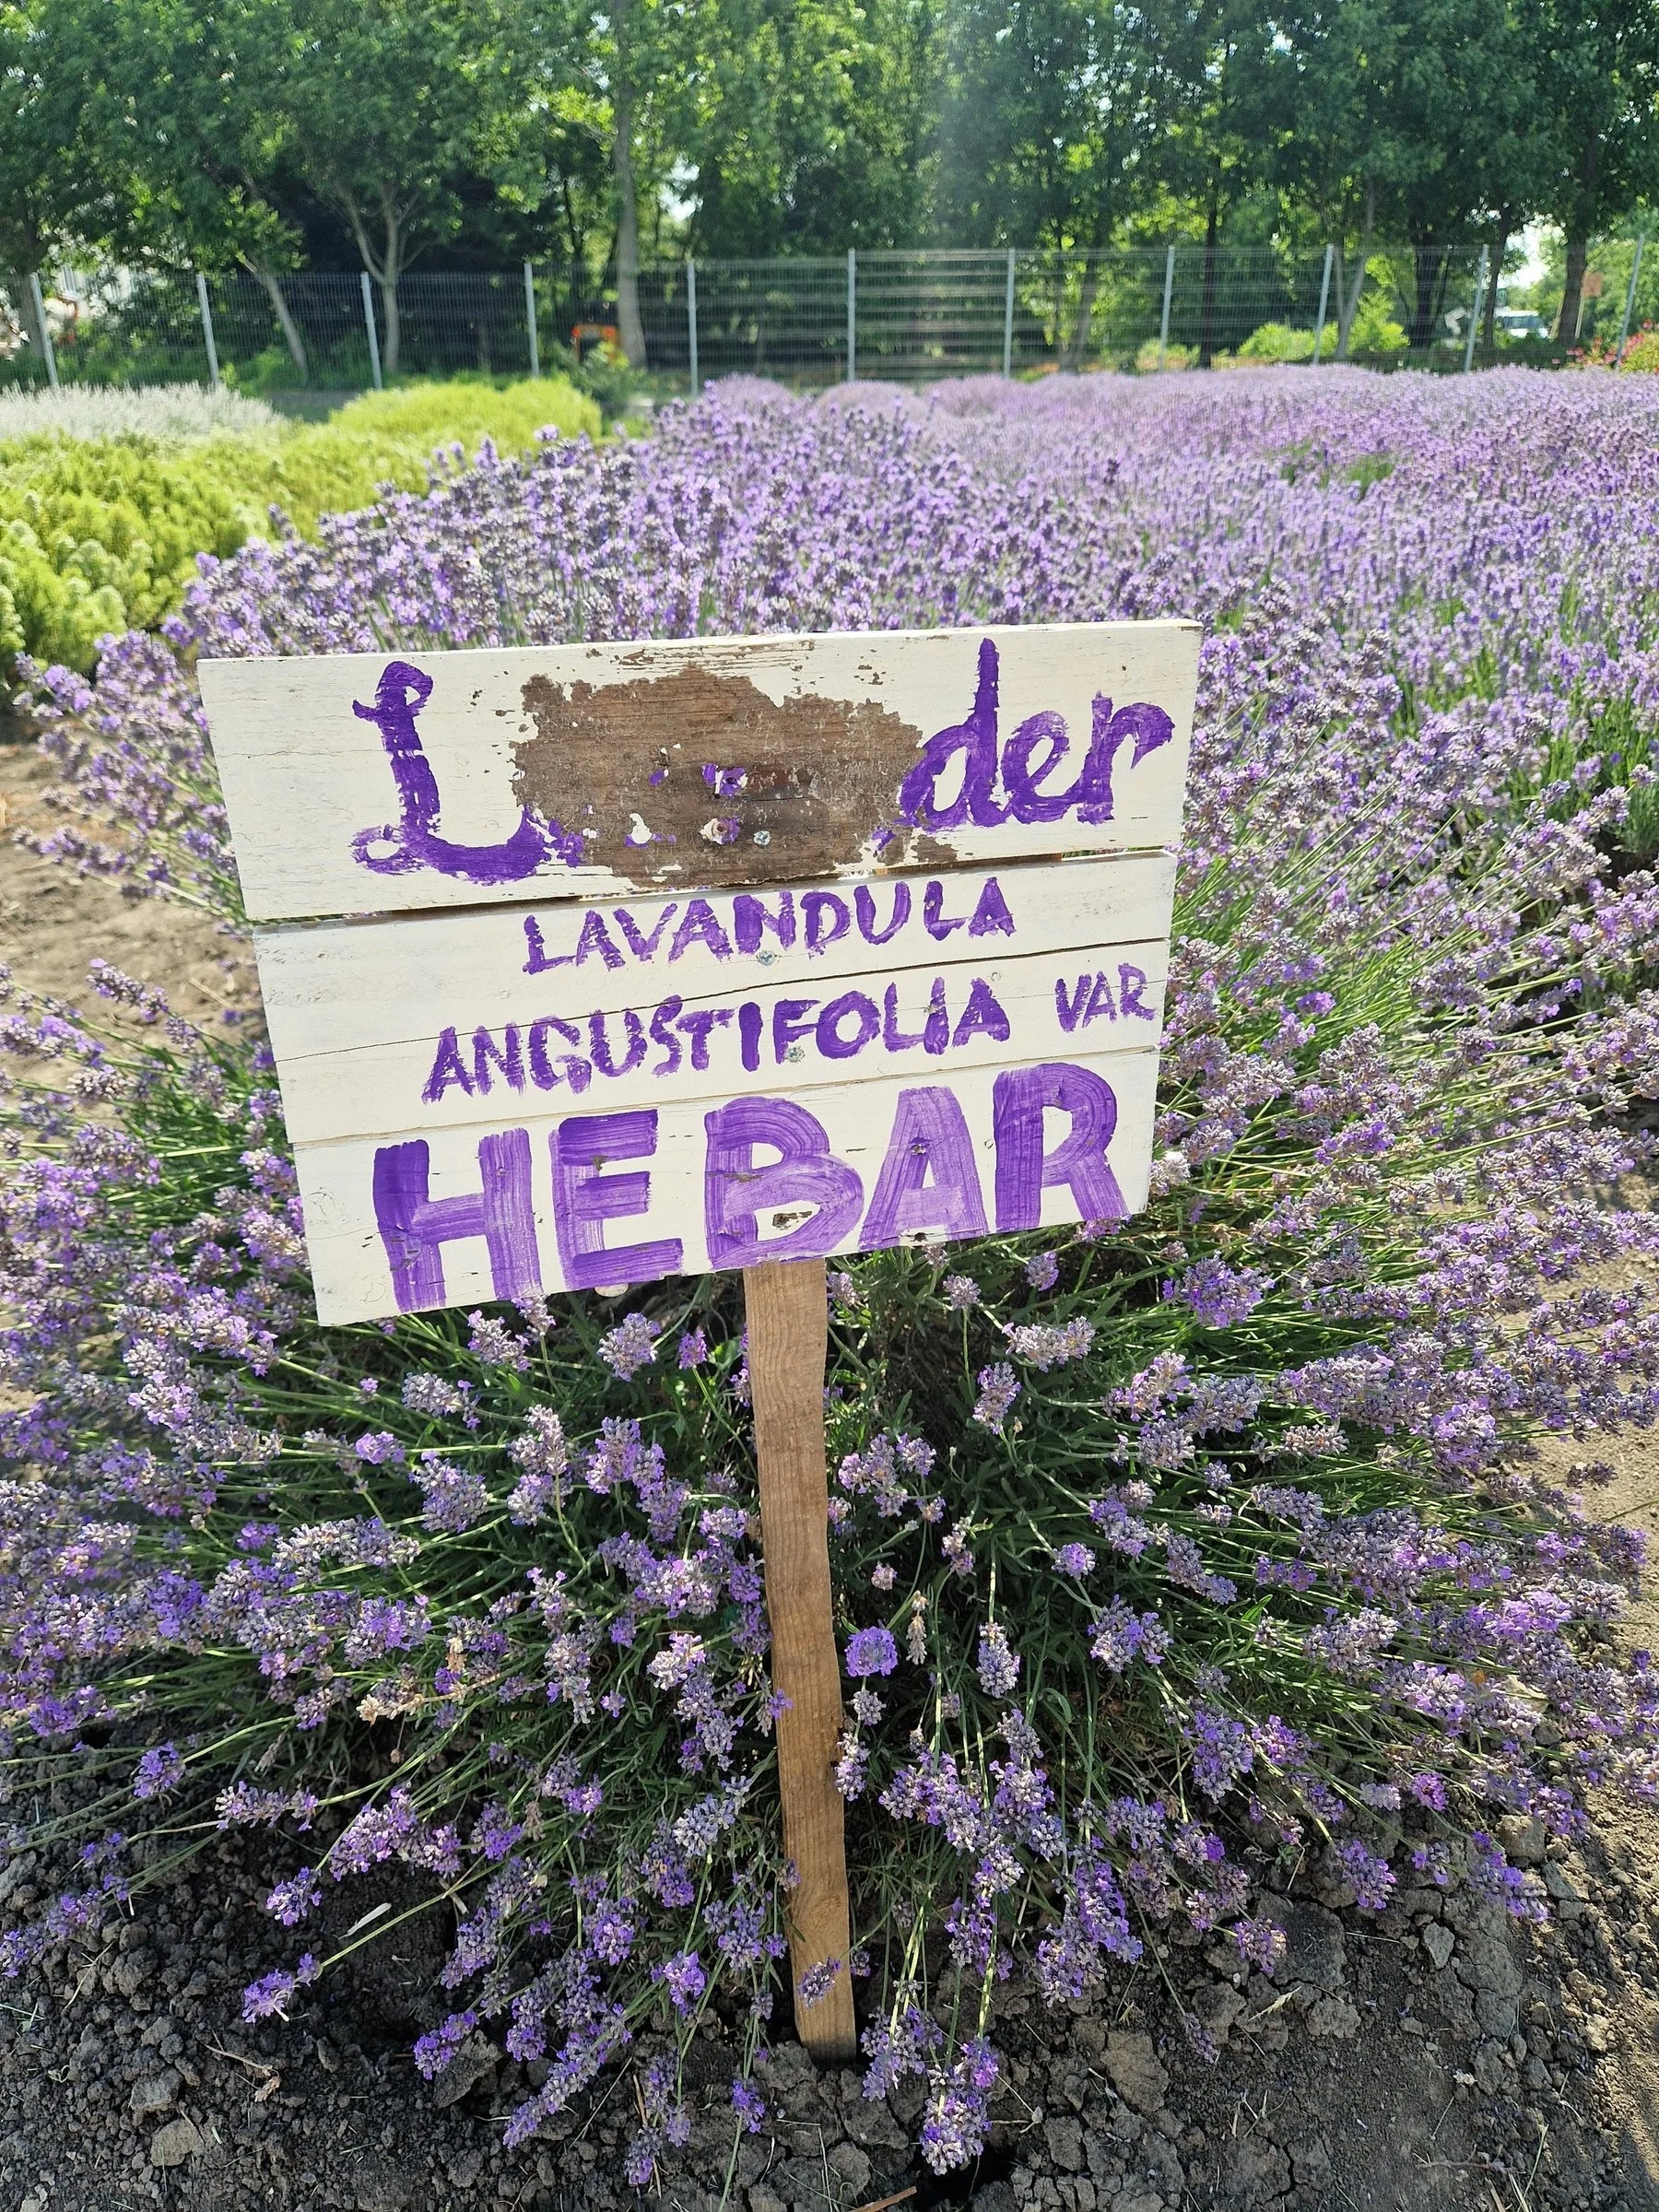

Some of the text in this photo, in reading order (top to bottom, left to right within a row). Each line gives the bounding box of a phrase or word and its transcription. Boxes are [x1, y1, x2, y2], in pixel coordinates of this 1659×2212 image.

[351, 636, 1175, 886] Lder
[523, 876, 1016, 974] LAVANDULA
[421, 962, 1156, 1102] ANGUSTIFOLIA VAR
[373, 1062, 1125, 1312] HEBAR
